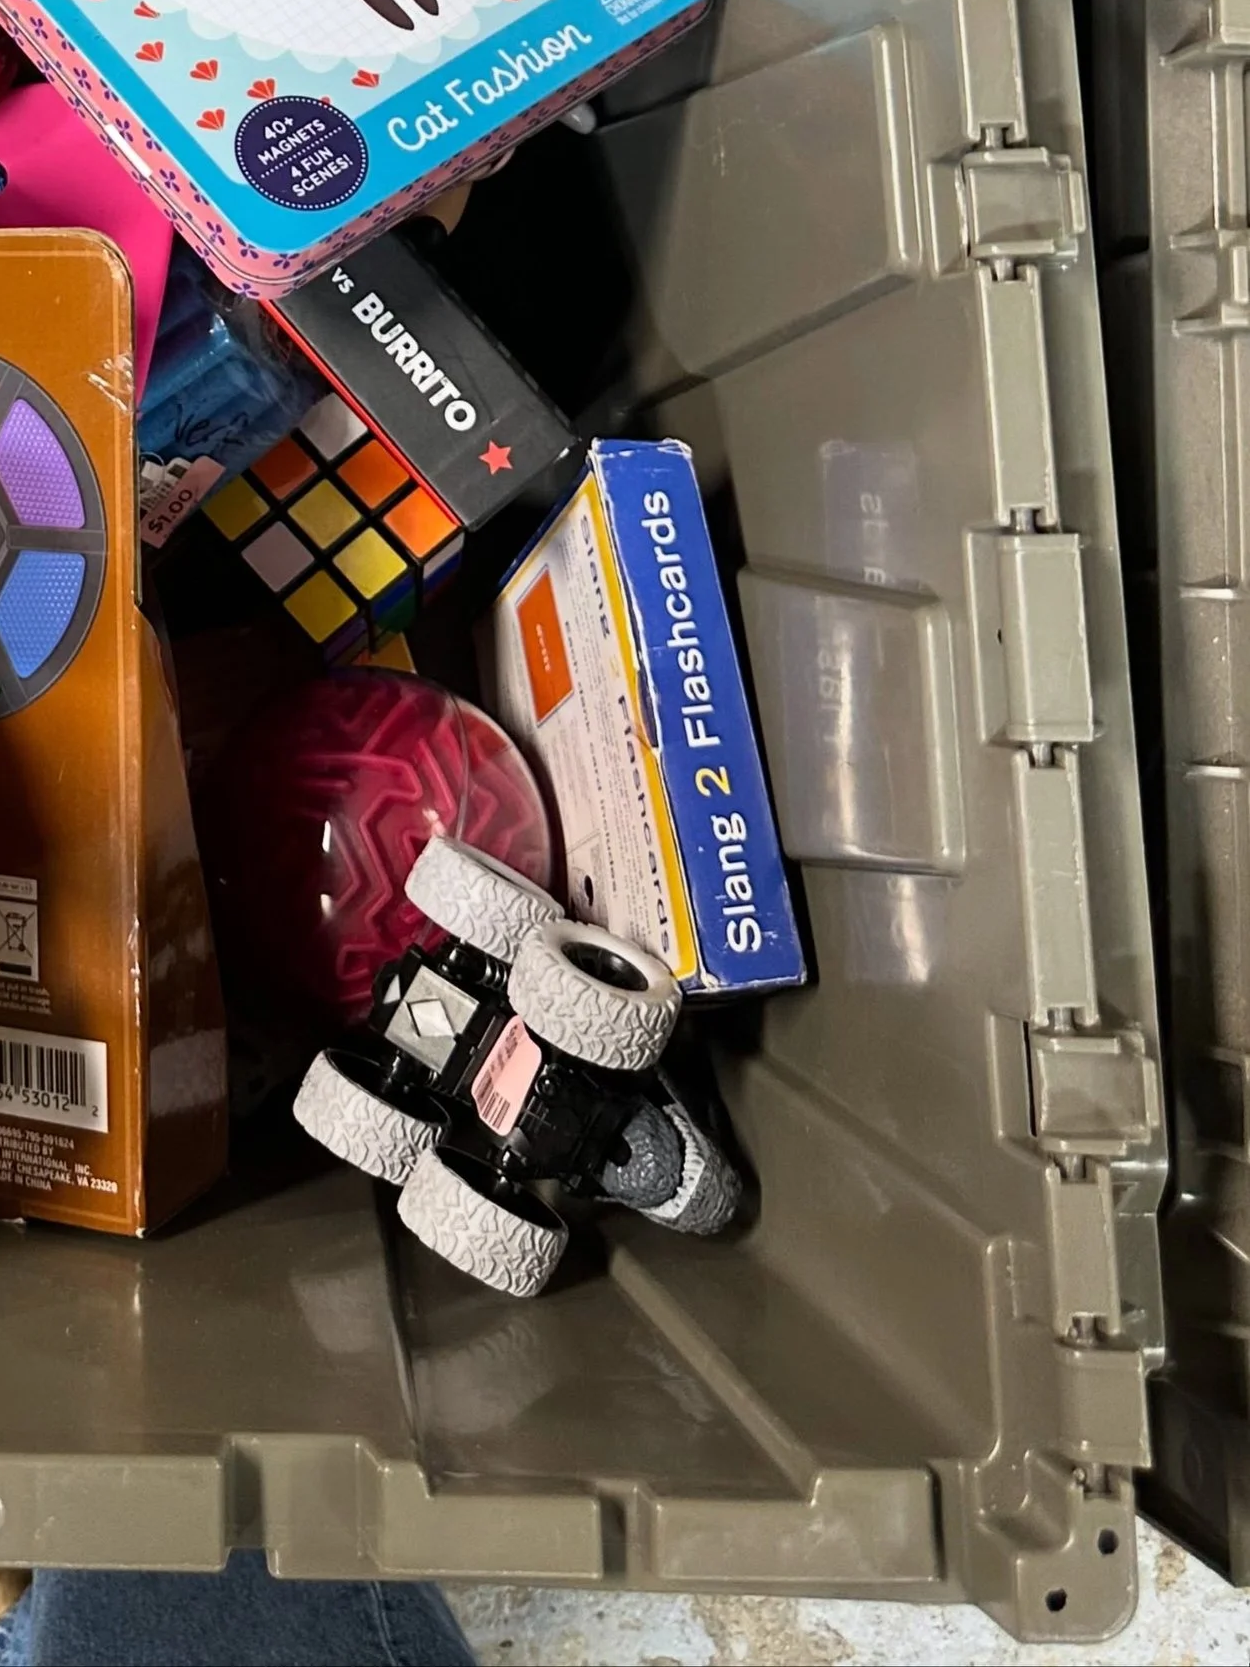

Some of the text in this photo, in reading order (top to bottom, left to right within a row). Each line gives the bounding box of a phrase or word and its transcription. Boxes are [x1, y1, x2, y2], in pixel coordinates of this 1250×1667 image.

[387, 23, 594, 153] Cat Fashion
[257, 118, 326, 165] MAGNETS
[264, 116, 294, 140] 40+
[290, 145, 334, 178] 4 FUN
[291, 153, 354, 197] SCENES!
[351, 291, 477, 432] BURRITO
[148, 489, 194, 534] $1.00
[580, 514, 611, 639] Slang
[617, 693, 670, 953] Flashcards
[641, 490, 763, 953] Slang 2 Flashcards
[21, 1089, 71, 1112] 53012
[91, 1105, 99, 1117] 2
[41, 1145, 54, 1156] BY
[74, 1163, 93, 1176] INC.
[14, 1173, 24, 1184] IN
[25, 1175, 52, 1191] CHINA
[76, 1175, 89, 1187] VA
